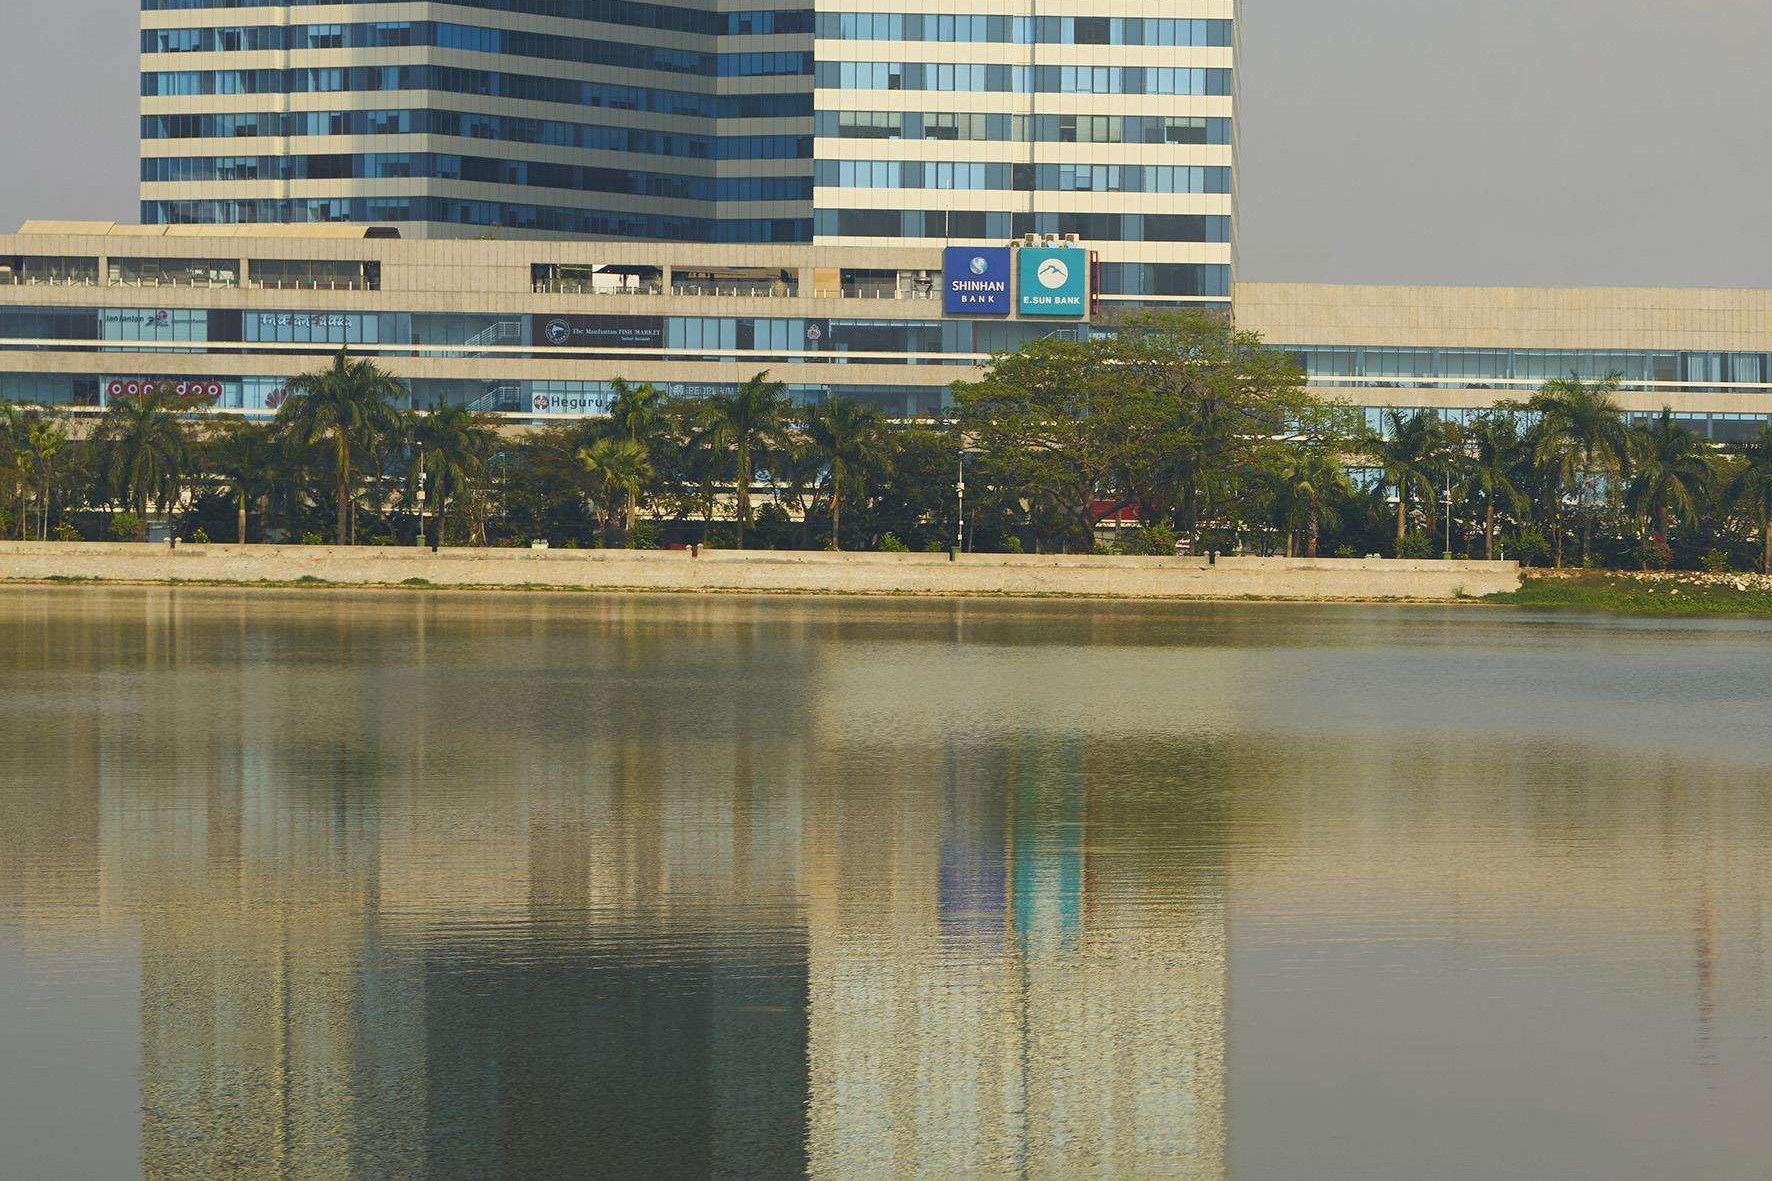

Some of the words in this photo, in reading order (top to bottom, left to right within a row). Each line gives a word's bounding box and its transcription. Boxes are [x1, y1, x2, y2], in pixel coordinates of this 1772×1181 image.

[952, 280, 1005, 292] SHINHAN
[961, 295, 995, 304] BANK
[1023, 296, 1052, 305] E.SUN
[1054, 297, 1081, 305] BANK
[573, 327, 583, 335] The
[585, 327, 618, 335] Manhattan
[618, 328, 634, 336] FISH
[551, 396, 602, 409] Heguru
